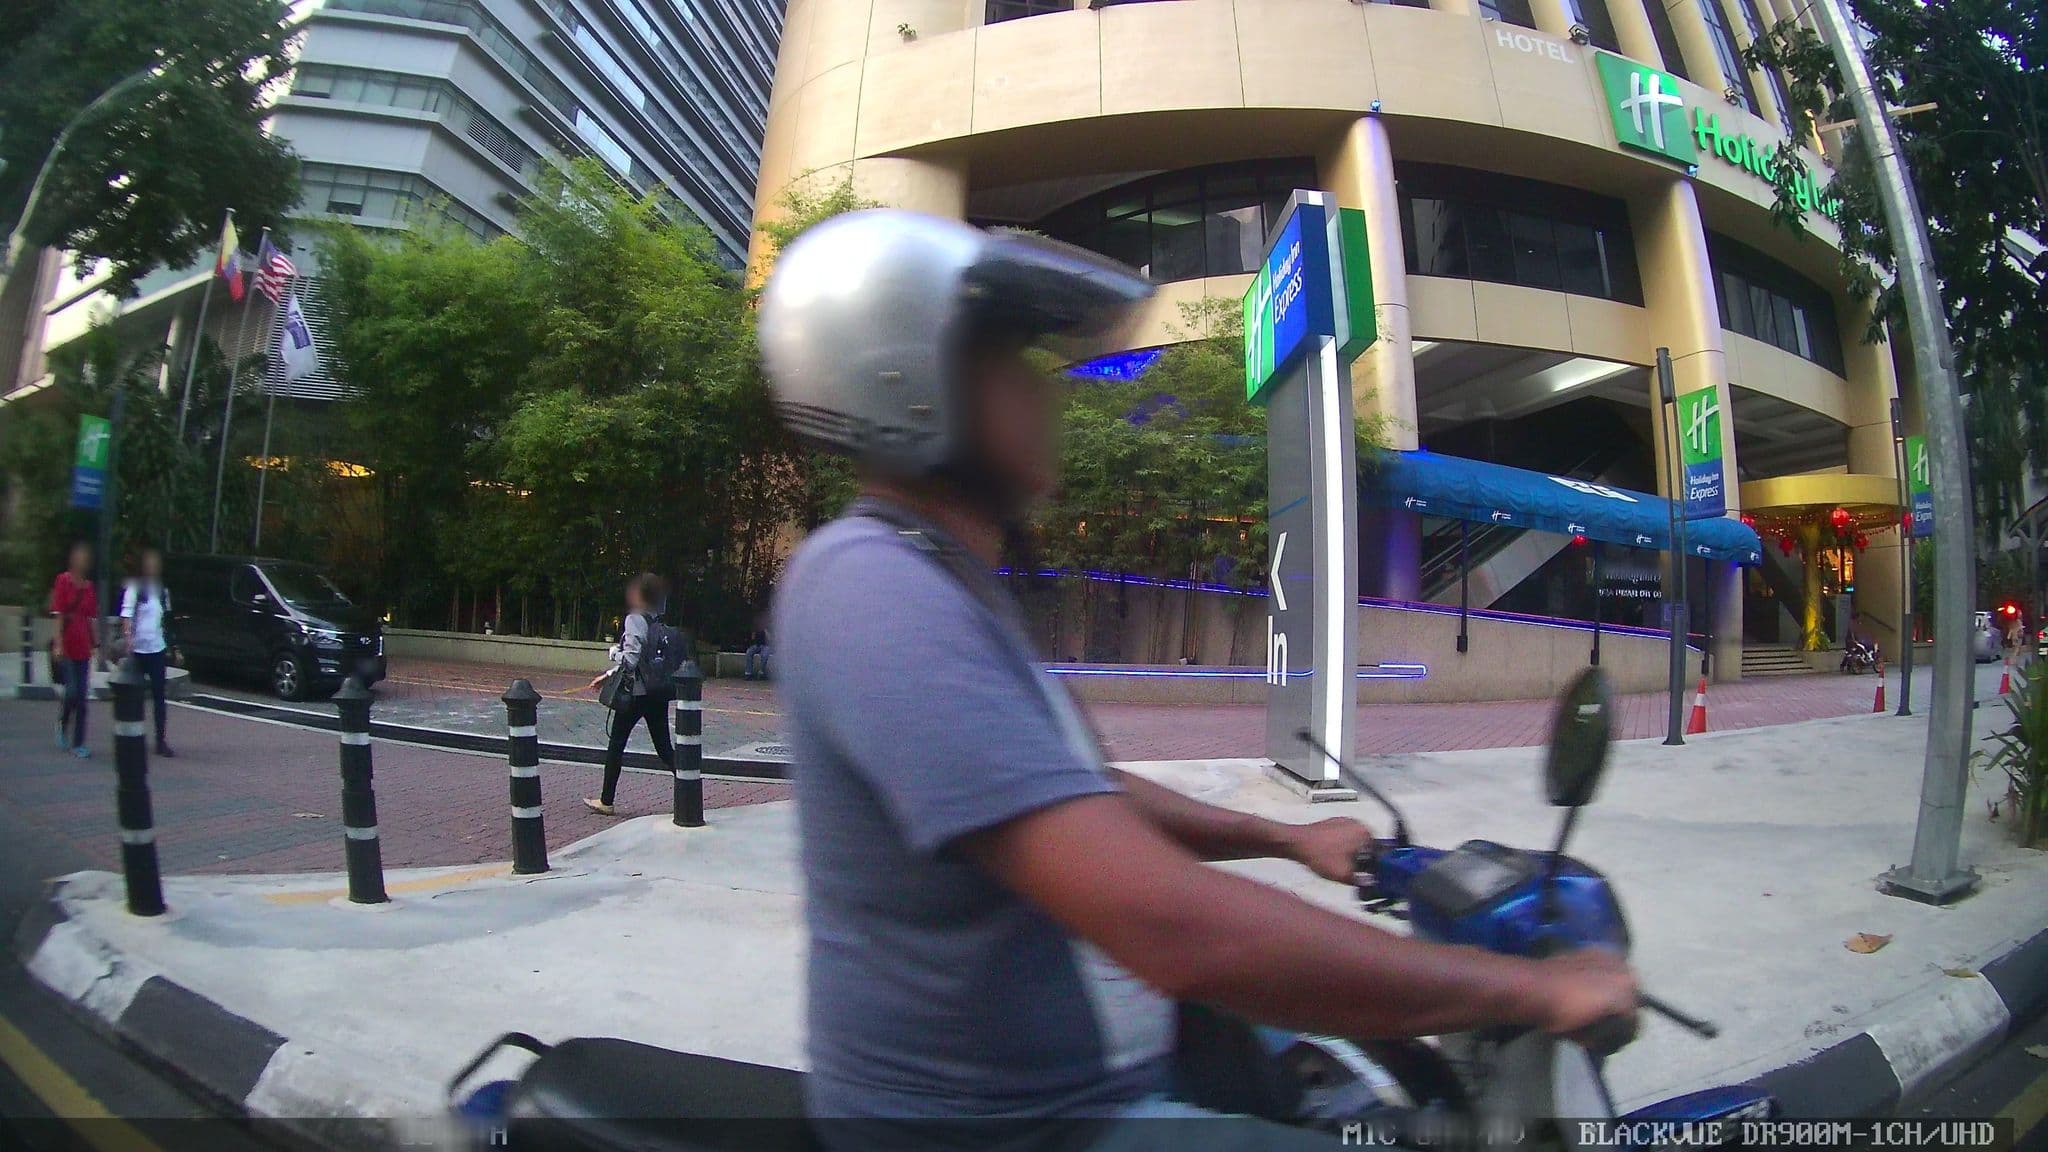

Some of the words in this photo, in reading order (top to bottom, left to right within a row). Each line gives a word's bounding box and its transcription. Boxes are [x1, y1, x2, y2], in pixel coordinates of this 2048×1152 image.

[1496, 29, 1574, 64] HOTEL
[1693, 106, 1811, 212] Holidy
[1274, 266, 1303, 325] Express
[1690, 474, 1712, 486] Holiday
[1690, 485, 1719, 502] Express
